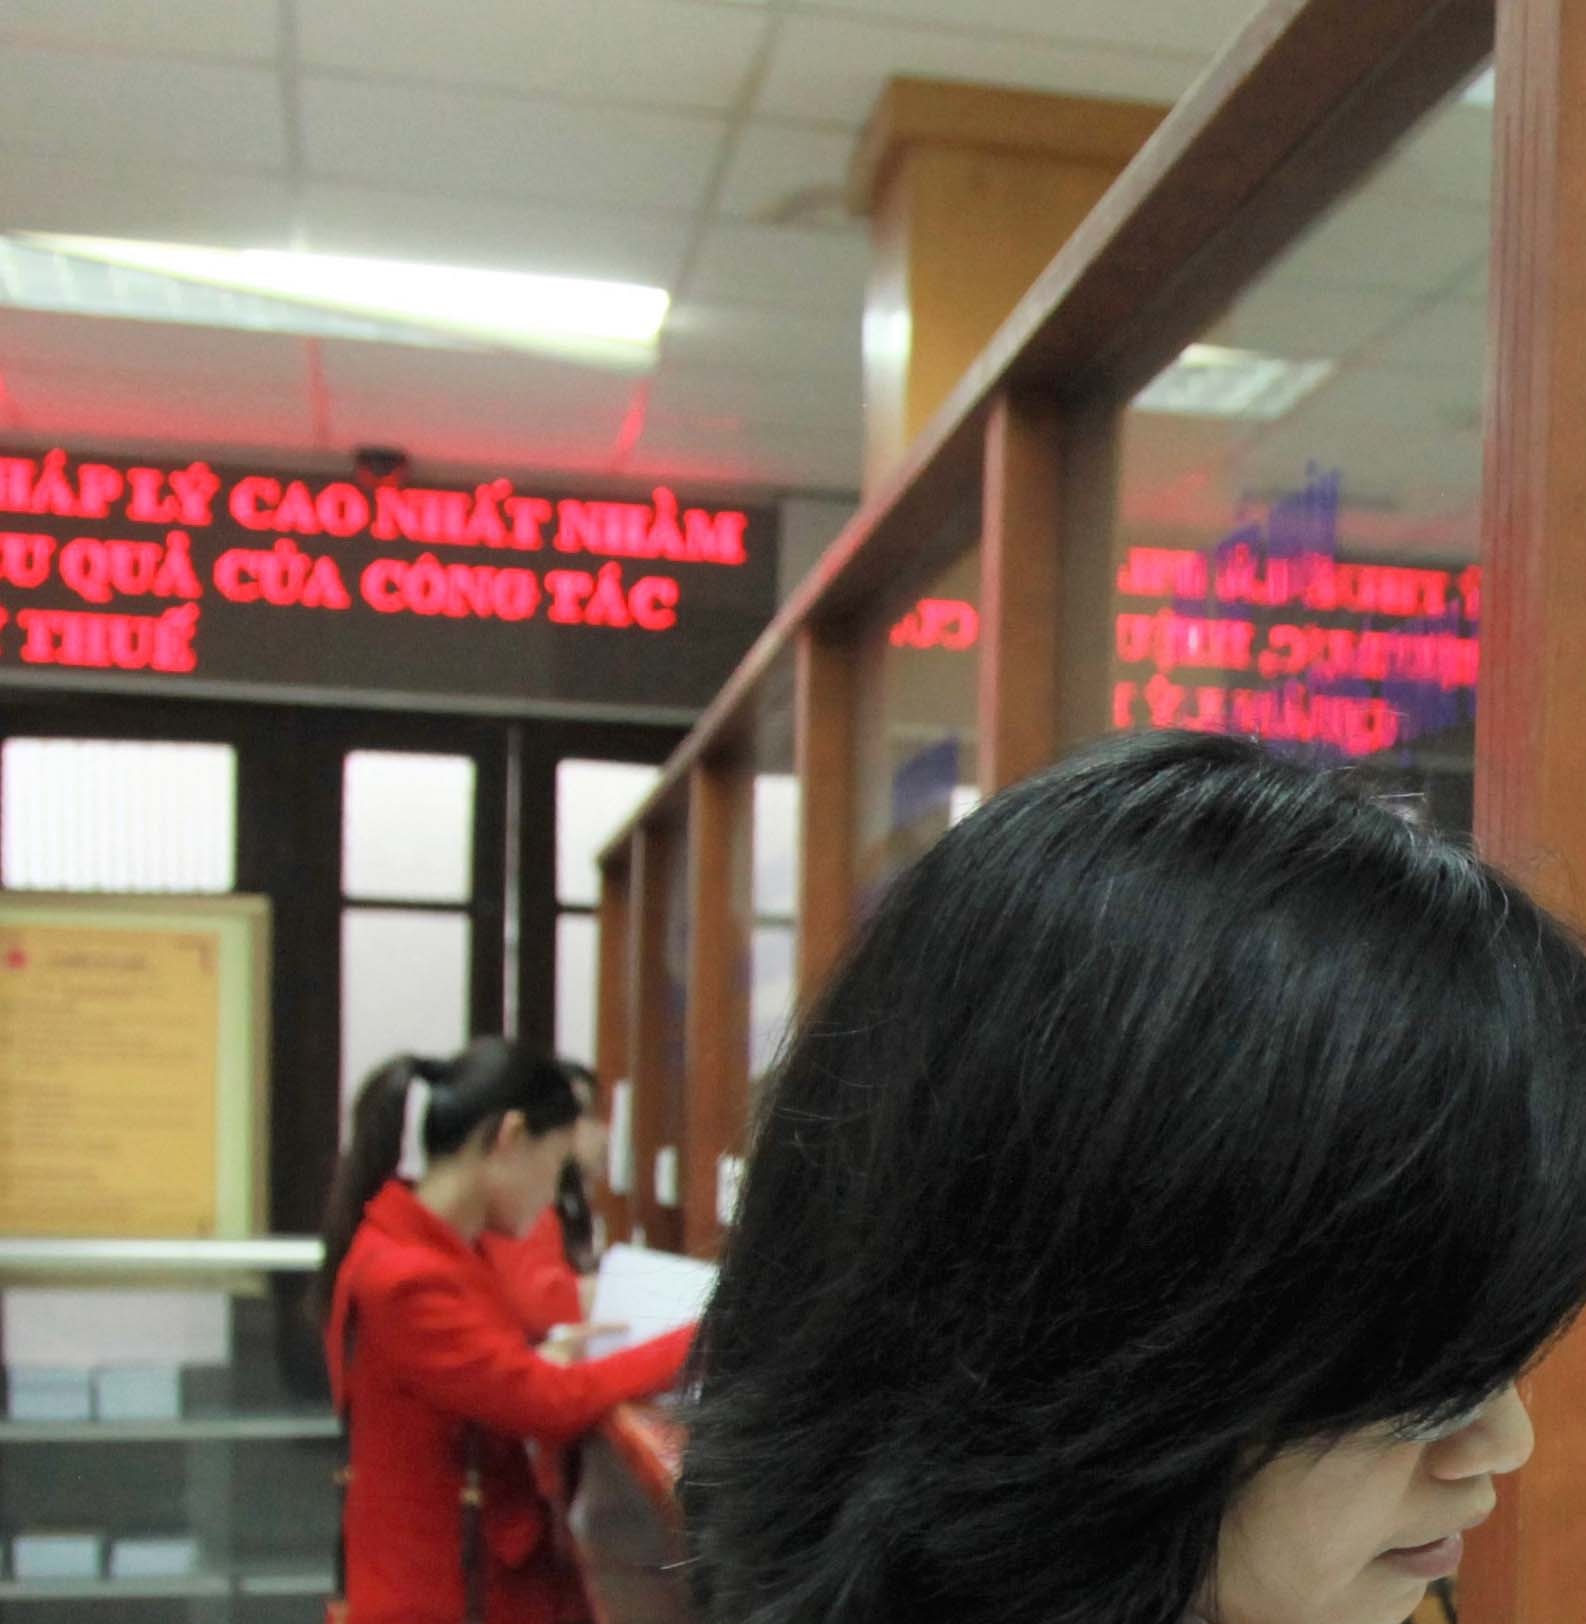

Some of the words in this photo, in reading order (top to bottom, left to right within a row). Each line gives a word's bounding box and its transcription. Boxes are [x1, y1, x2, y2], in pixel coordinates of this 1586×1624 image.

[228, 475, 370, 538] CAO
[360, 552, 541, 621] CÔNG
[544, 560, 681, 631] TÁC
